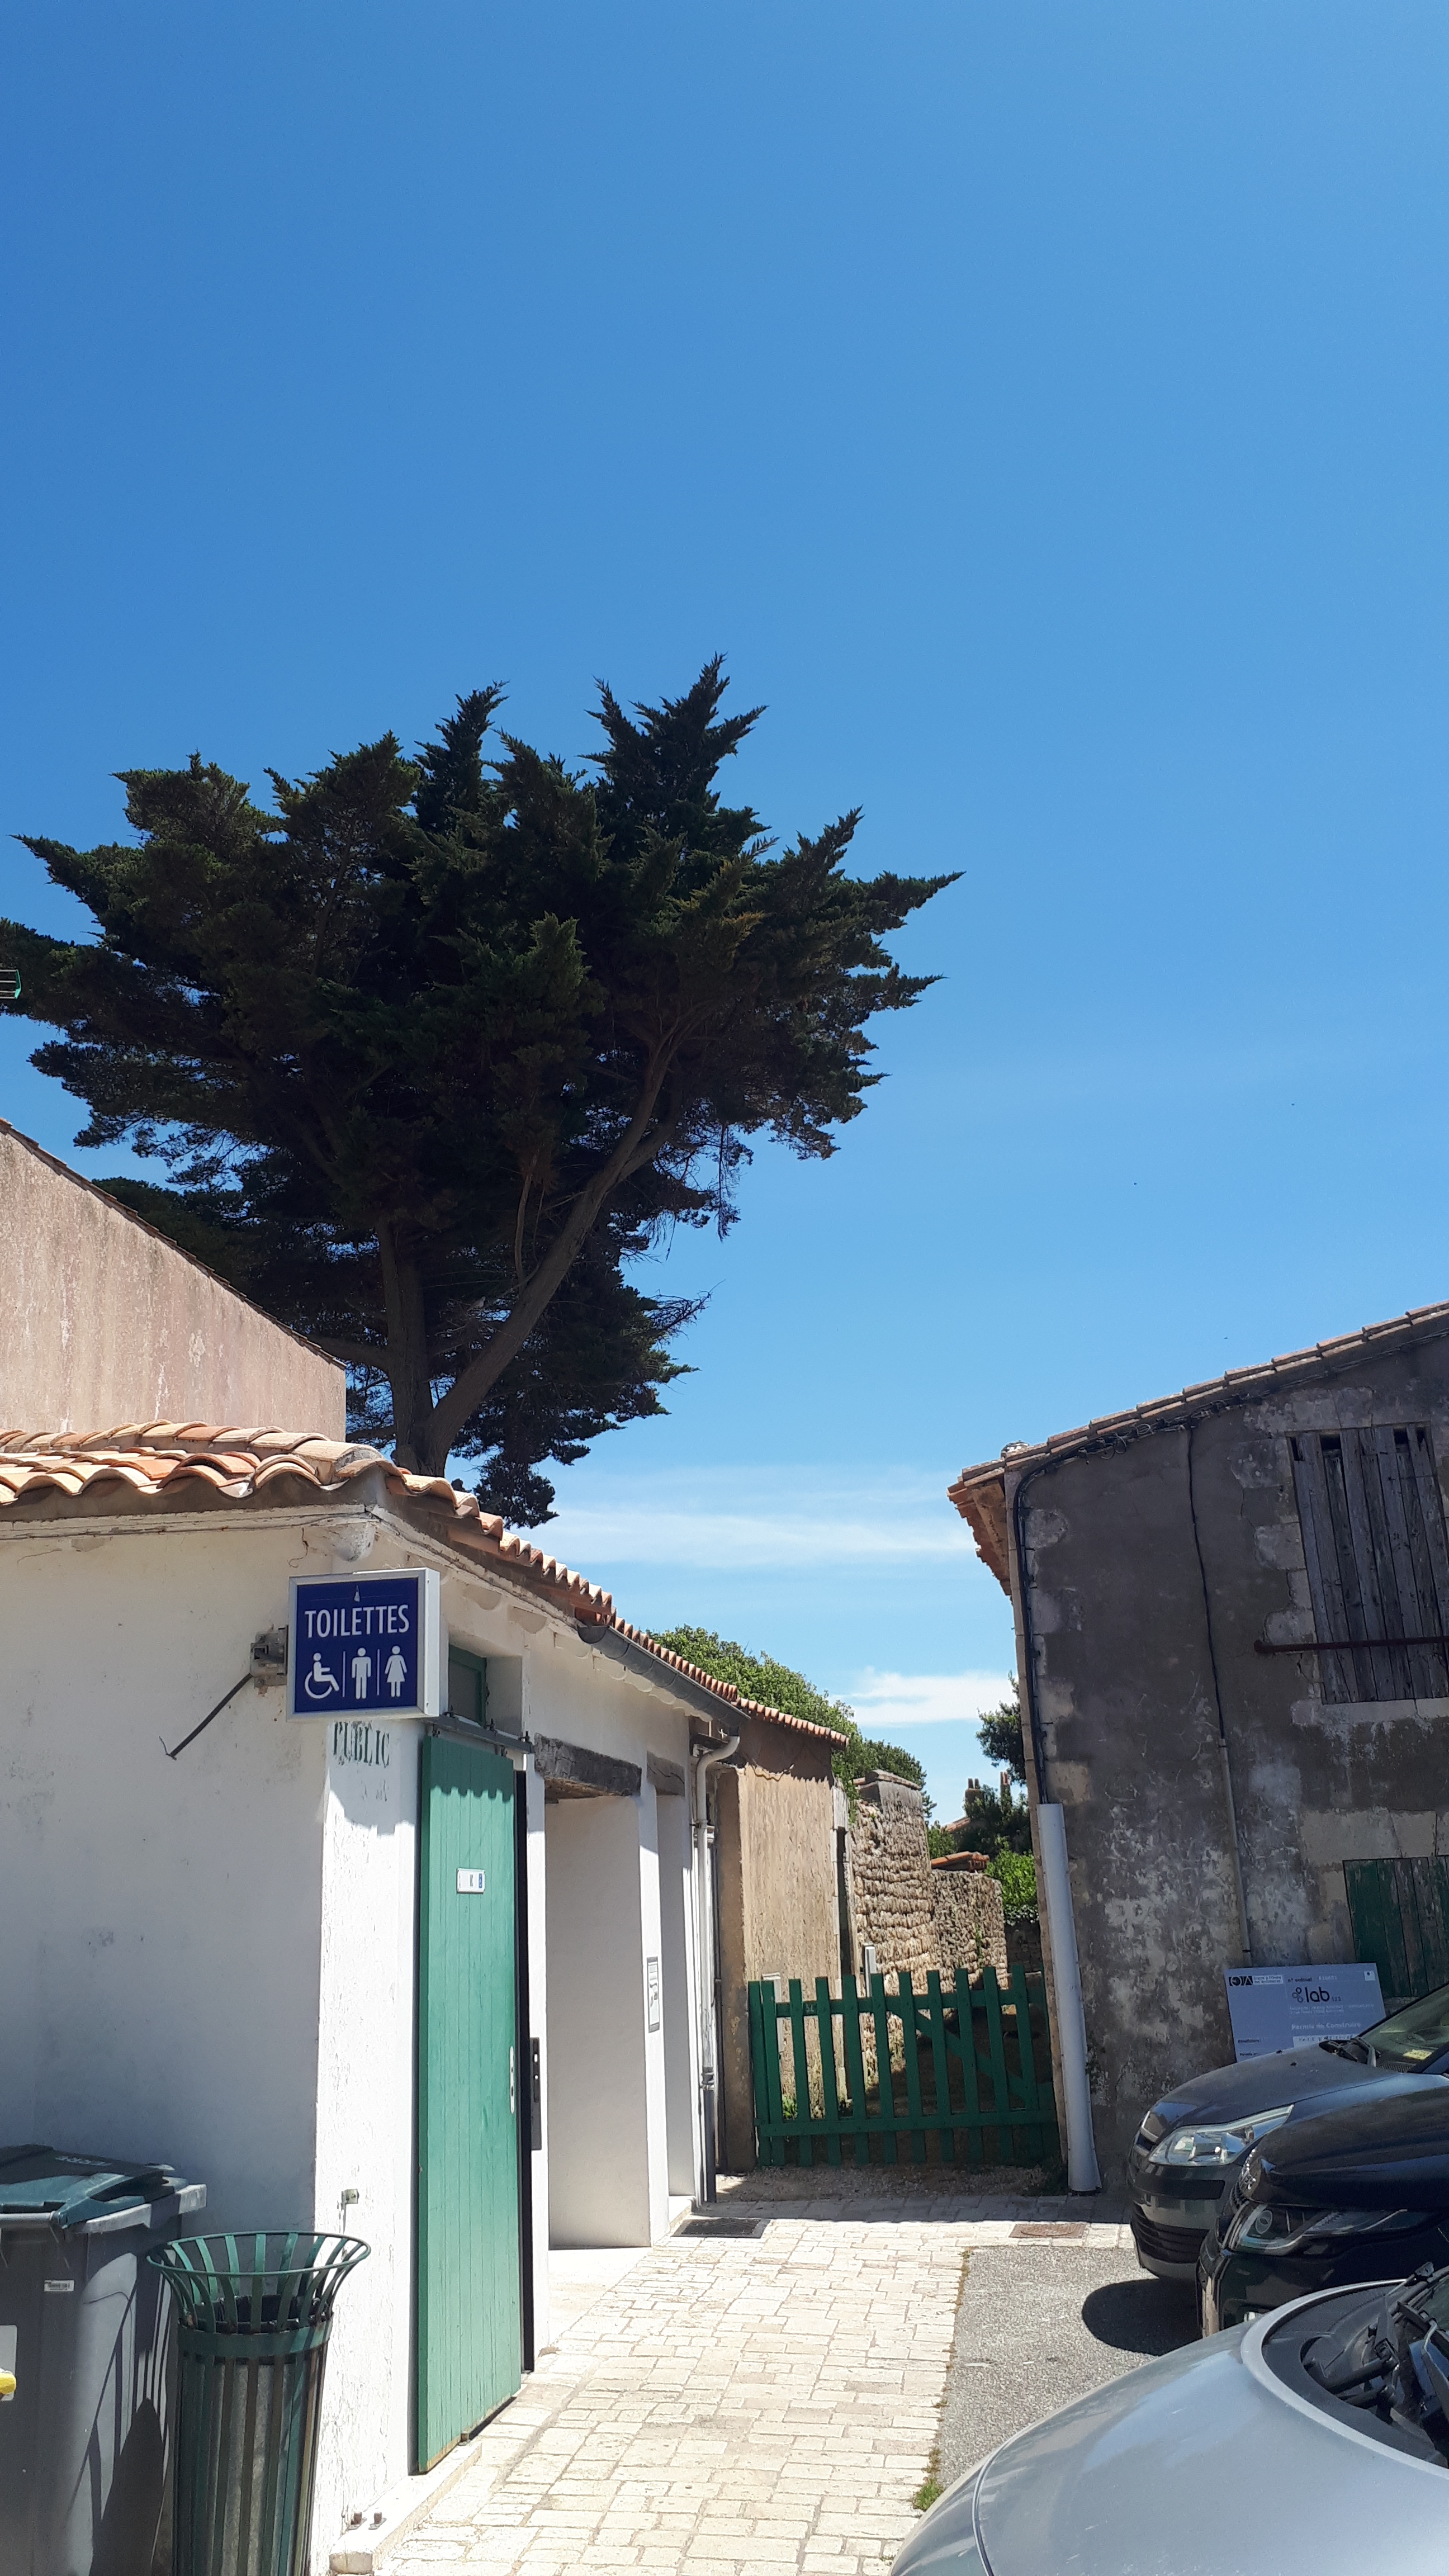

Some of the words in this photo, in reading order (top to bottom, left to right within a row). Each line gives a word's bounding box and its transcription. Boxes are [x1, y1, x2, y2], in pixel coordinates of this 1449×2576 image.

[304, 1604, 410, 1639] TOILETTES
[333, 1720, 390, 1768] PUBLIC
[1304, 1986, 1330, 2002] lab
